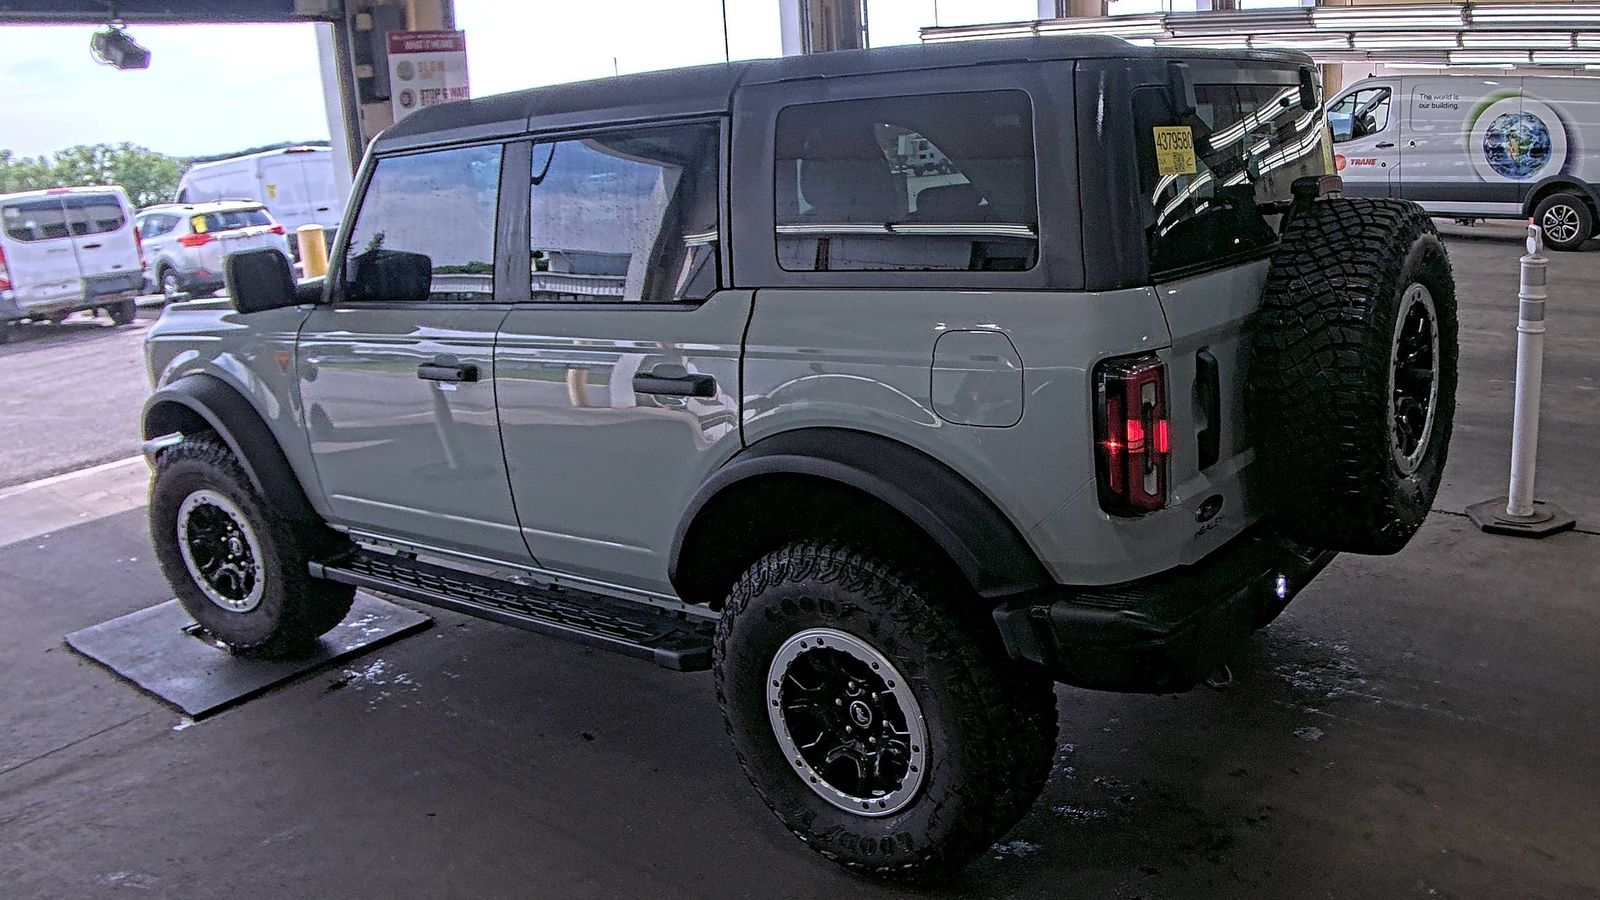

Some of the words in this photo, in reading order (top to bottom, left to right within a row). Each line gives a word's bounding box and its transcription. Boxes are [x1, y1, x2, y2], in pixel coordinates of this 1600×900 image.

[420, 88, 440, 99] STOP
[449, 86, 469, 98] WAIT
[1419, 93, 1432, 101] The
[1433, 93, 1452, 101] world
[1453, 93, 1459, 101] is
[1431, 101, 1460, 110] building.
[1350, 158, 1378, 166] TRANE
